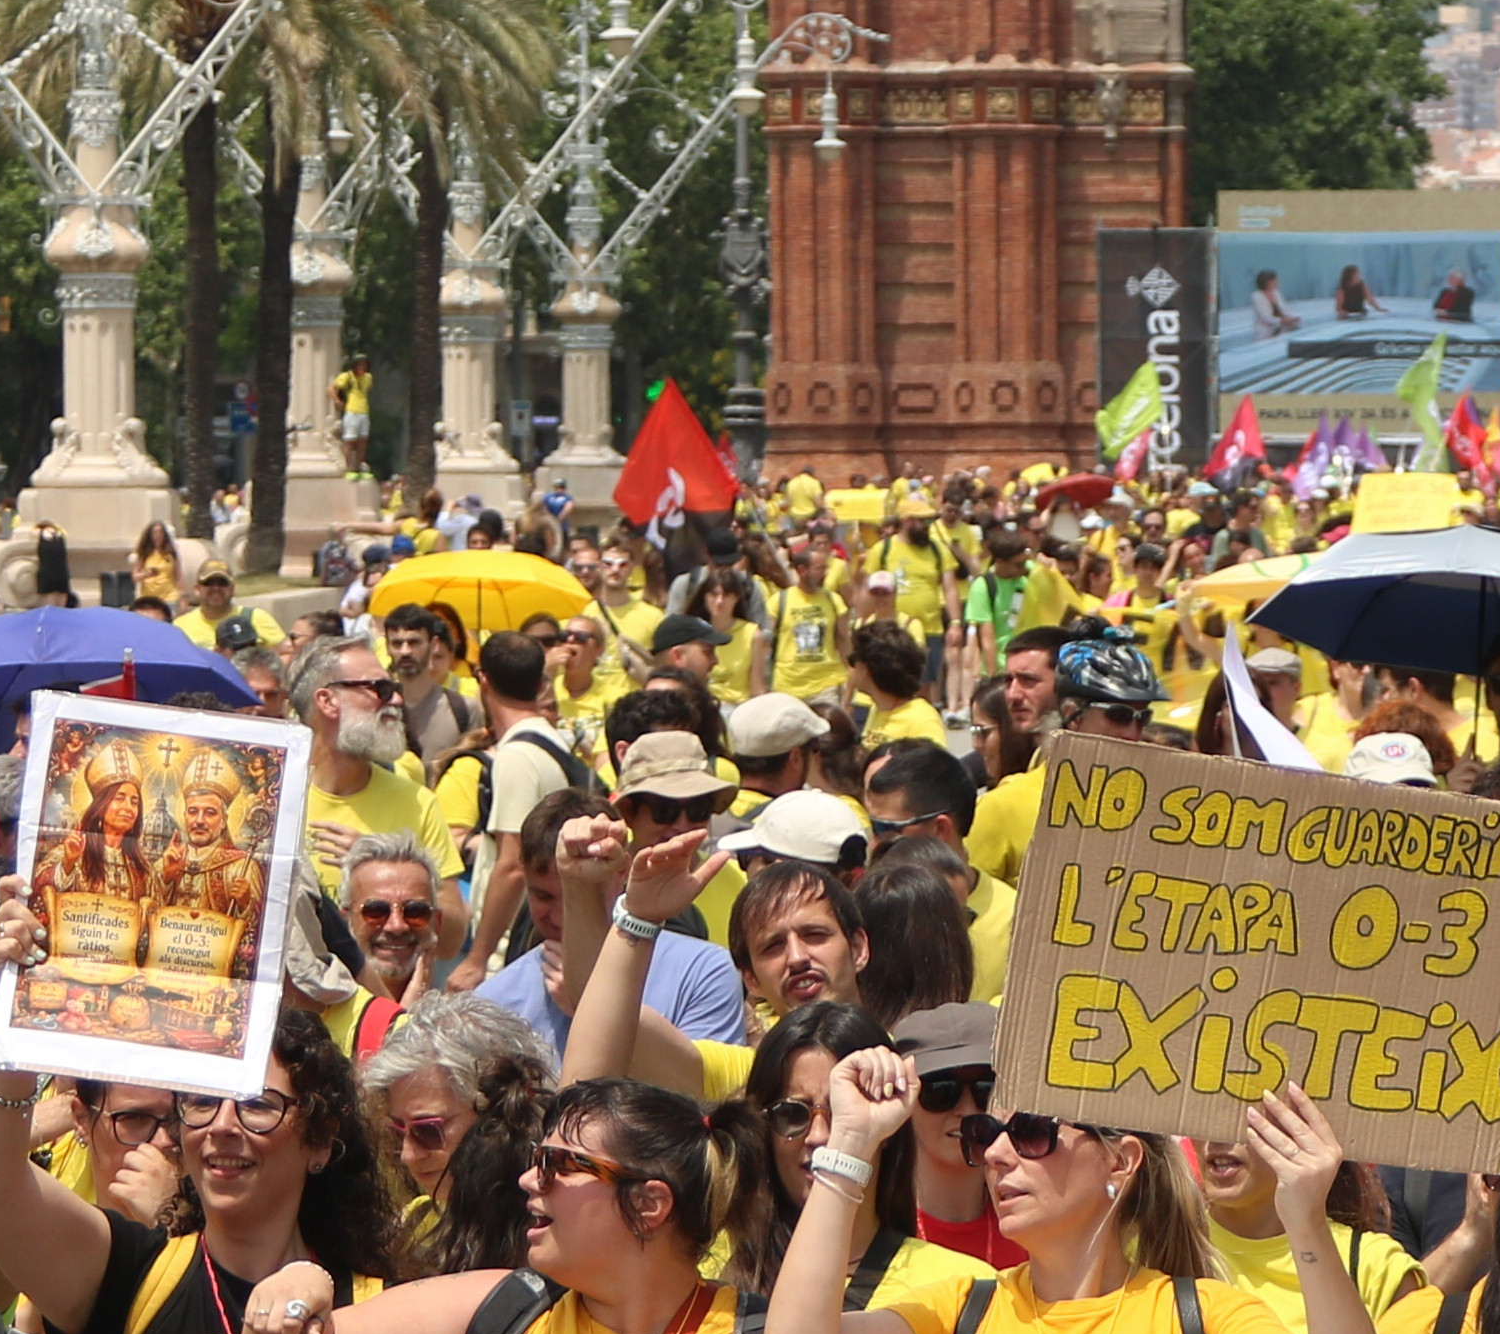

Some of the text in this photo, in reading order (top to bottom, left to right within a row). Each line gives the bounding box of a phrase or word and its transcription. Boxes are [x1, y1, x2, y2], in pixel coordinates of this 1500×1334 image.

[1049, 758, 1147, 831] NO
[1150, 785, 1287, 849] SOM
[1052, 862, 1300, 956] L'ETAPA
[62, 910, 130, 930] Santificades
[159, 916, 203, 933] Benaurat
[70, 925, 120, 942] siguin les
[159, 954, 172, 965] als
[166, 945, 211, 960] reconegut
